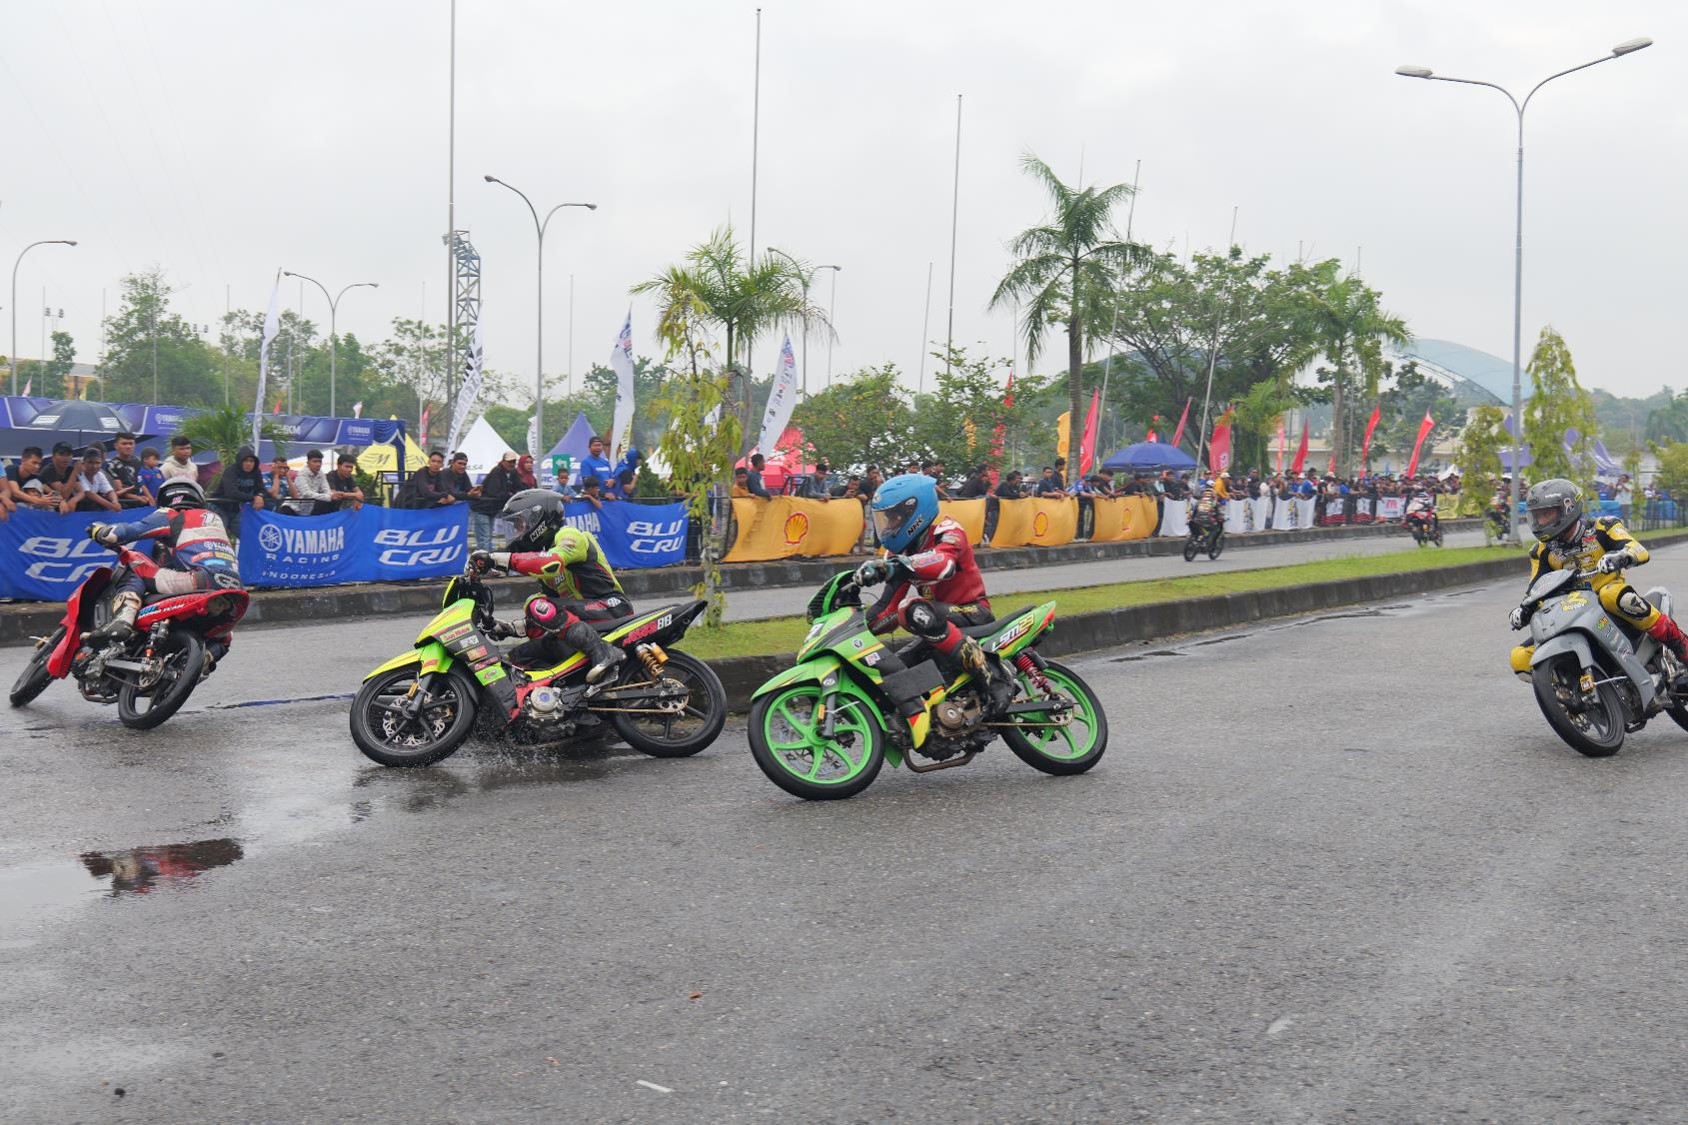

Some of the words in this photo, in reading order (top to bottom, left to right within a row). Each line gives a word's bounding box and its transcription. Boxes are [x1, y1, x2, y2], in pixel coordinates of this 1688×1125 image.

[373, 525, 460, 546] BLU
[626, 519, 684, 537] BLU
[282, 526, 345, 554] YAMAHA
[630, 535, 684, 554] CRU
[266, 553, 340, 564] RACING
[378, 543, 463, 566] CRU
